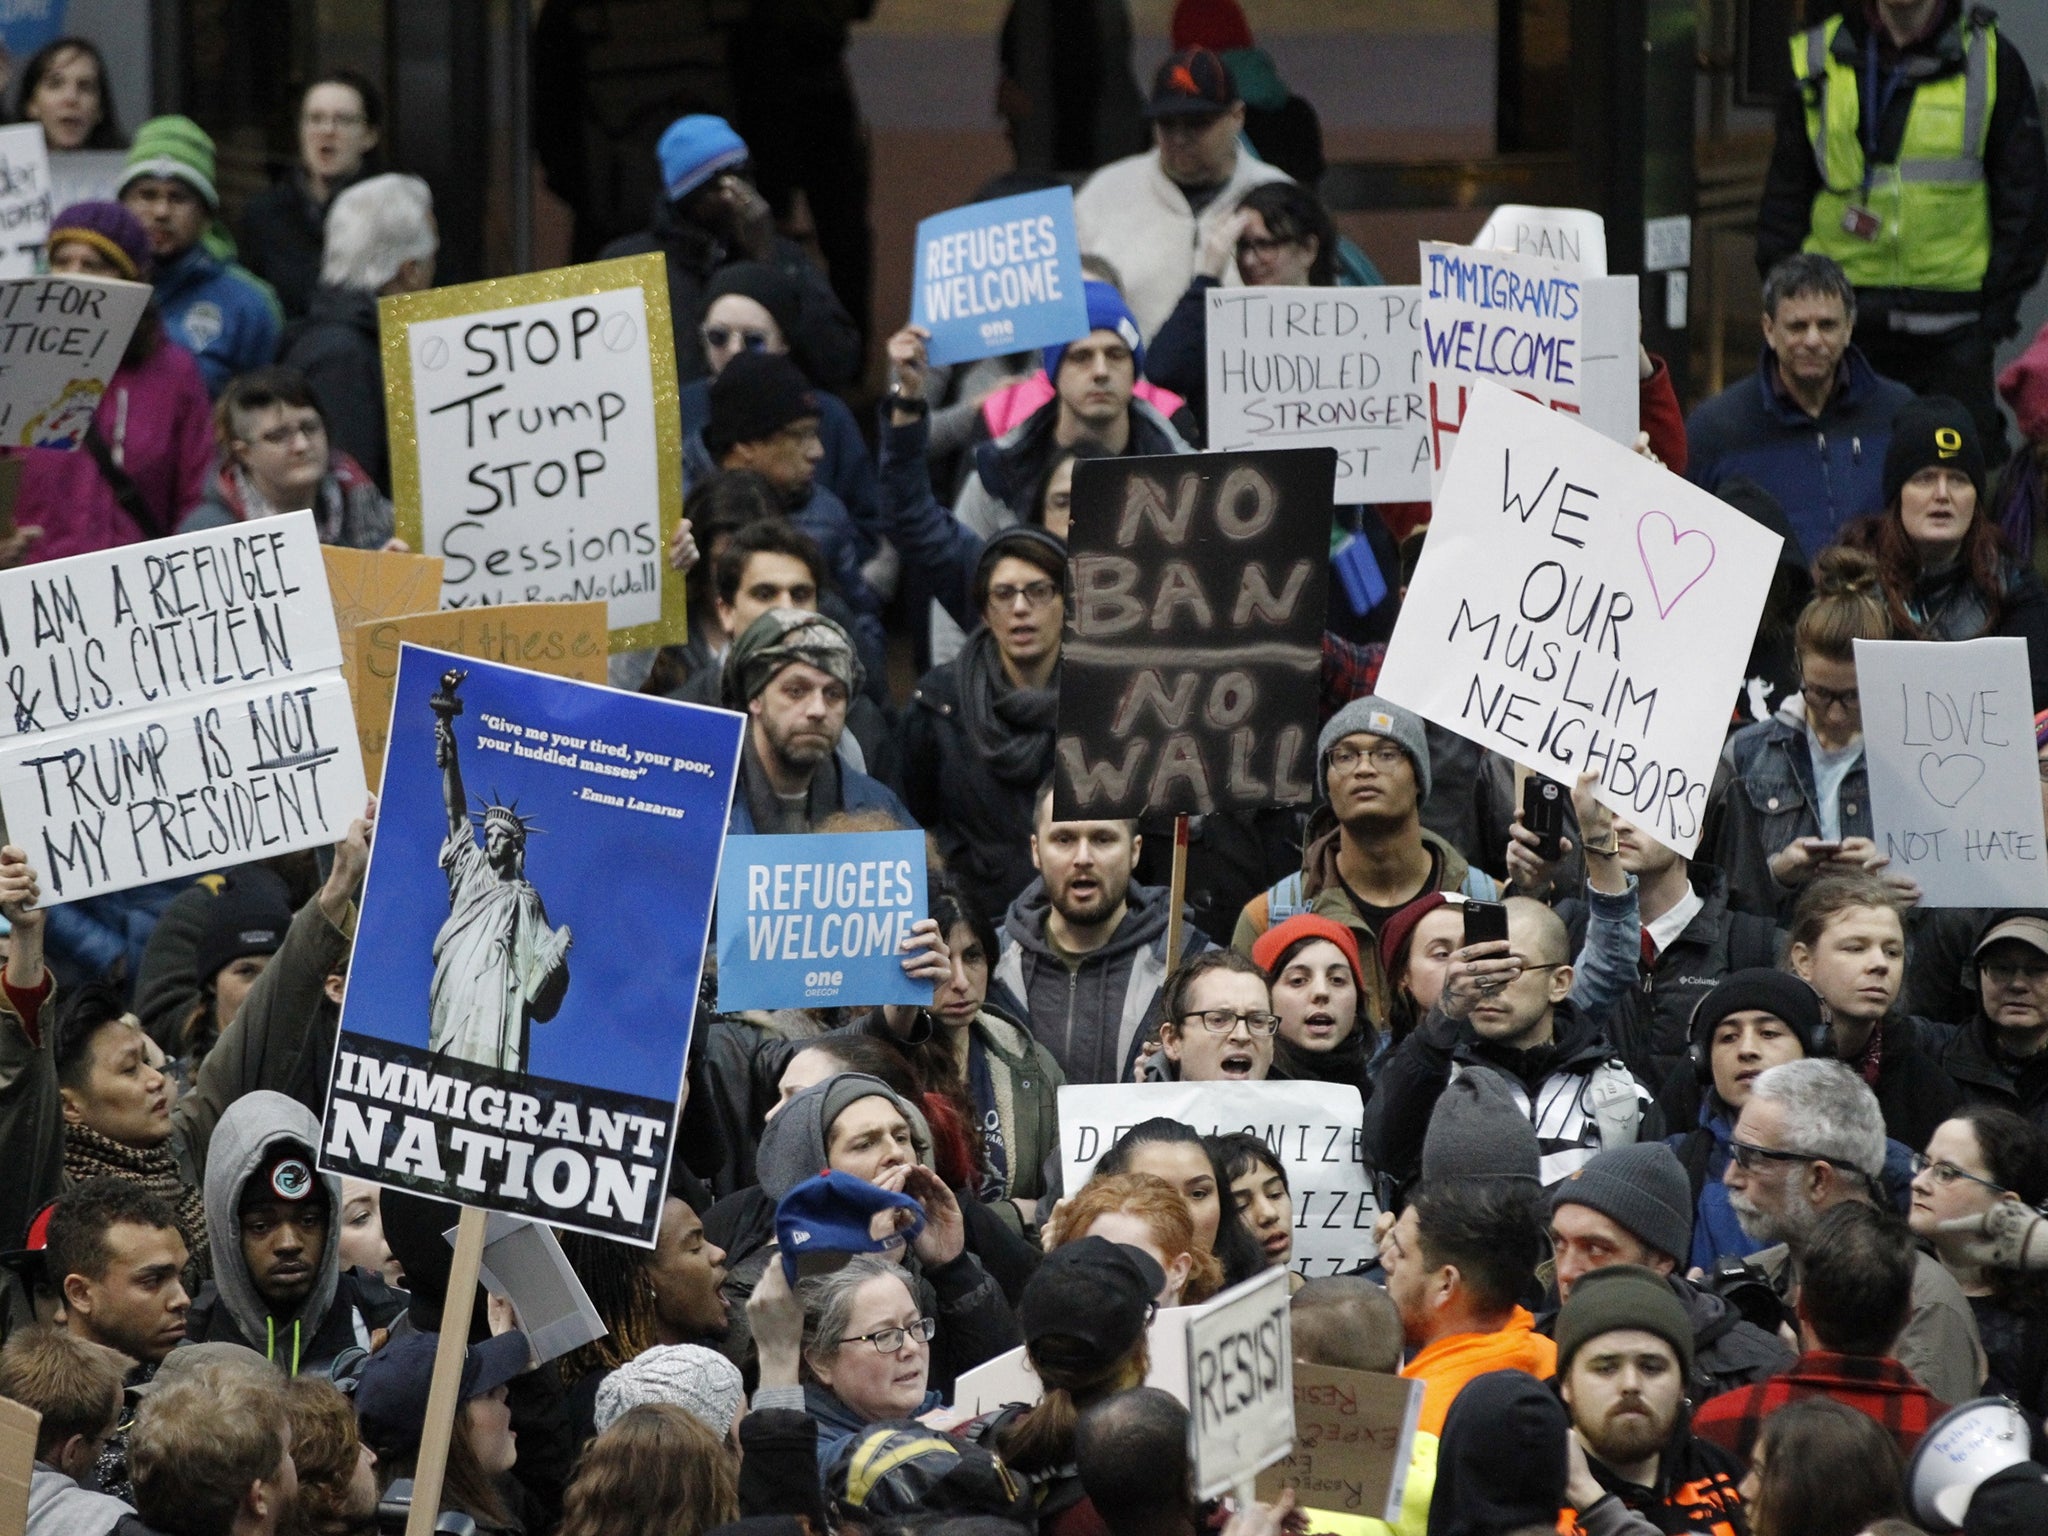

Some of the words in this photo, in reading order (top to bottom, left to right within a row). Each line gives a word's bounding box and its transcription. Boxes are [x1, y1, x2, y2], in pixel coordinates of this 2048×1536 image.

[927, 215, 1057, 280] REFUGEES
[1515, 222, 1581, 263] BAN
[36, 280, 107, 320] FOR
[926, 258, 1063, 323] WELCOME
[1429, 253, 1580, 321] IMMIGRANTS
[0, 322, 109, 368] TICE!
[464, 306, 599, 377] STOP
[1221, 349, 1381, 395] HUDDLED
[1424, 317, 1577, 386] WELCOME
[430, 384, 626, 448] Trump
[1242, 391, 1427, 436] STRONGER
[465, 449, 606, 515] STOP
[1117, 464, 1277, 547] NO
[1503, 448, 1600, 550] WE
[441, 520, 656, 584] Sessions
[31, 574, 88, 648] AM
[111, 563, 138, 628] A
[144, 531, 301, 619] REFUGEE
[1067, 553, 1312, 636] BAN
[1519, 560, 1634, 662] OUR
[6, 664, 46, 734] &
[49, 637, 124, 722] U.S.
[131, 602, 293, 701] CITIZEN
[1448, 599, 1658, 739] MUSLIM
[1110, 669, 1256, 737] NO
[1902, 683, 2010, 747] LOVE
[19, 723, 169, 817] TRUMP
[193, 706, 234, 785] IS
[249, 686, 322, 768] NOT
[477, 734, 512, 752] your
[514, 741, 578, 769] huddled
[579, 757, 649, 781] masses”
[480, 713, 523, 737] “Give
[525, 727, 549, 743] me
[550, 732, 587, 751] your
[590, 739, 632, 763] tired,
[634, 750, 673, 767] your
[673, 757, 716, 779] poor,
[1056, 724, 1313, 814] WALL
[1461, 674, 1707, 840] NEIGHBORS
[42, 810, 110, 897] MY
[127, 757, 332, 878] PRESIDENT
[580, 787, 625, 808] Emma
[626, 796, 686, 819] Lazarus
[1887, 828, 1949, 865] NOT
[1965, 828, 2037, 862] HATE
[748, 860, 913, 911] REFUGEES
[747, 911, 914, 961] WELCOME
[804, 970, 844, 987] one
[336, 1050, 666, 1158] IMMIGRANT
[325, 1098, 657, 1225] NATION
[1197, 1307, 1286, 1433] RESIST
